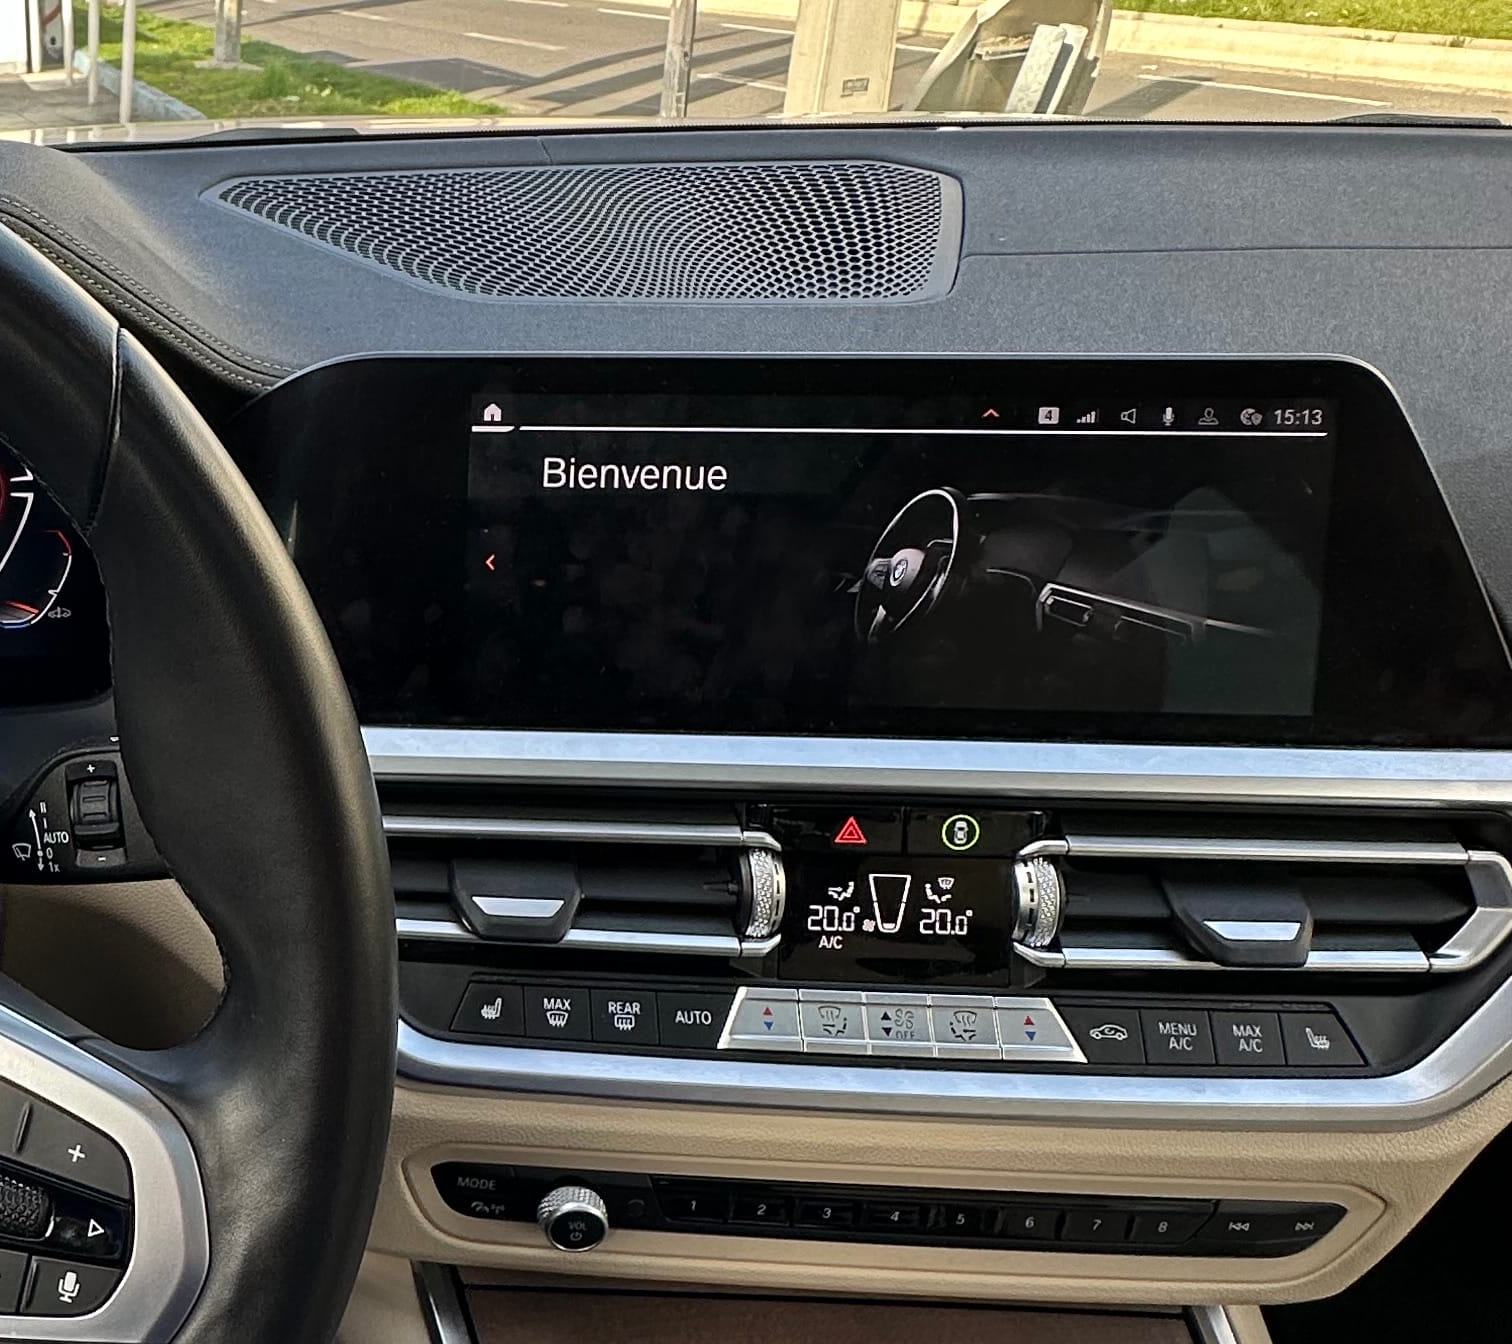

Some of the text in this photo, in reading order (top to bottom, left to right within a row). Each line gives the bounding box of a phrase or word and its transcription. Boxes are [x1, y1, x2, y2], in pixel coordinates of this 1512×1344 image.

[1274, 408, 1323, 425] 15:13
[542, 457, 728, 491] Bienvenue
[43, 831, 69, 844] AUTO
[818, 936, 843, 950] A/C
[543, 997, 571, 1011] MAX
[608, 1001, 641, 1015] REAR
[675, 1010, 712, 1025] AUTO
[1158, 1021, 1197, 1036] MENU
[1232, 1024, 1262, 1038] MAX
[1169, 1037, 1193, 1051] A/C
[1239, 1038, 1263, 1053] A/C
[457, 1176, 497, 1191] MODE
[756, 1204, 767, 1216] 2
[822, 1207, 832, 1219] 3
[889, 1210, 900, 1222] 4
[955, 1213, 965, 1225] 5
[1024, 1216, 1035, 1229] 6
[1092, 1219, 1102, 1231] 7
[1157, 1221, 1168, 1233] 8
[567, 1220, 587, 1232] VOL
